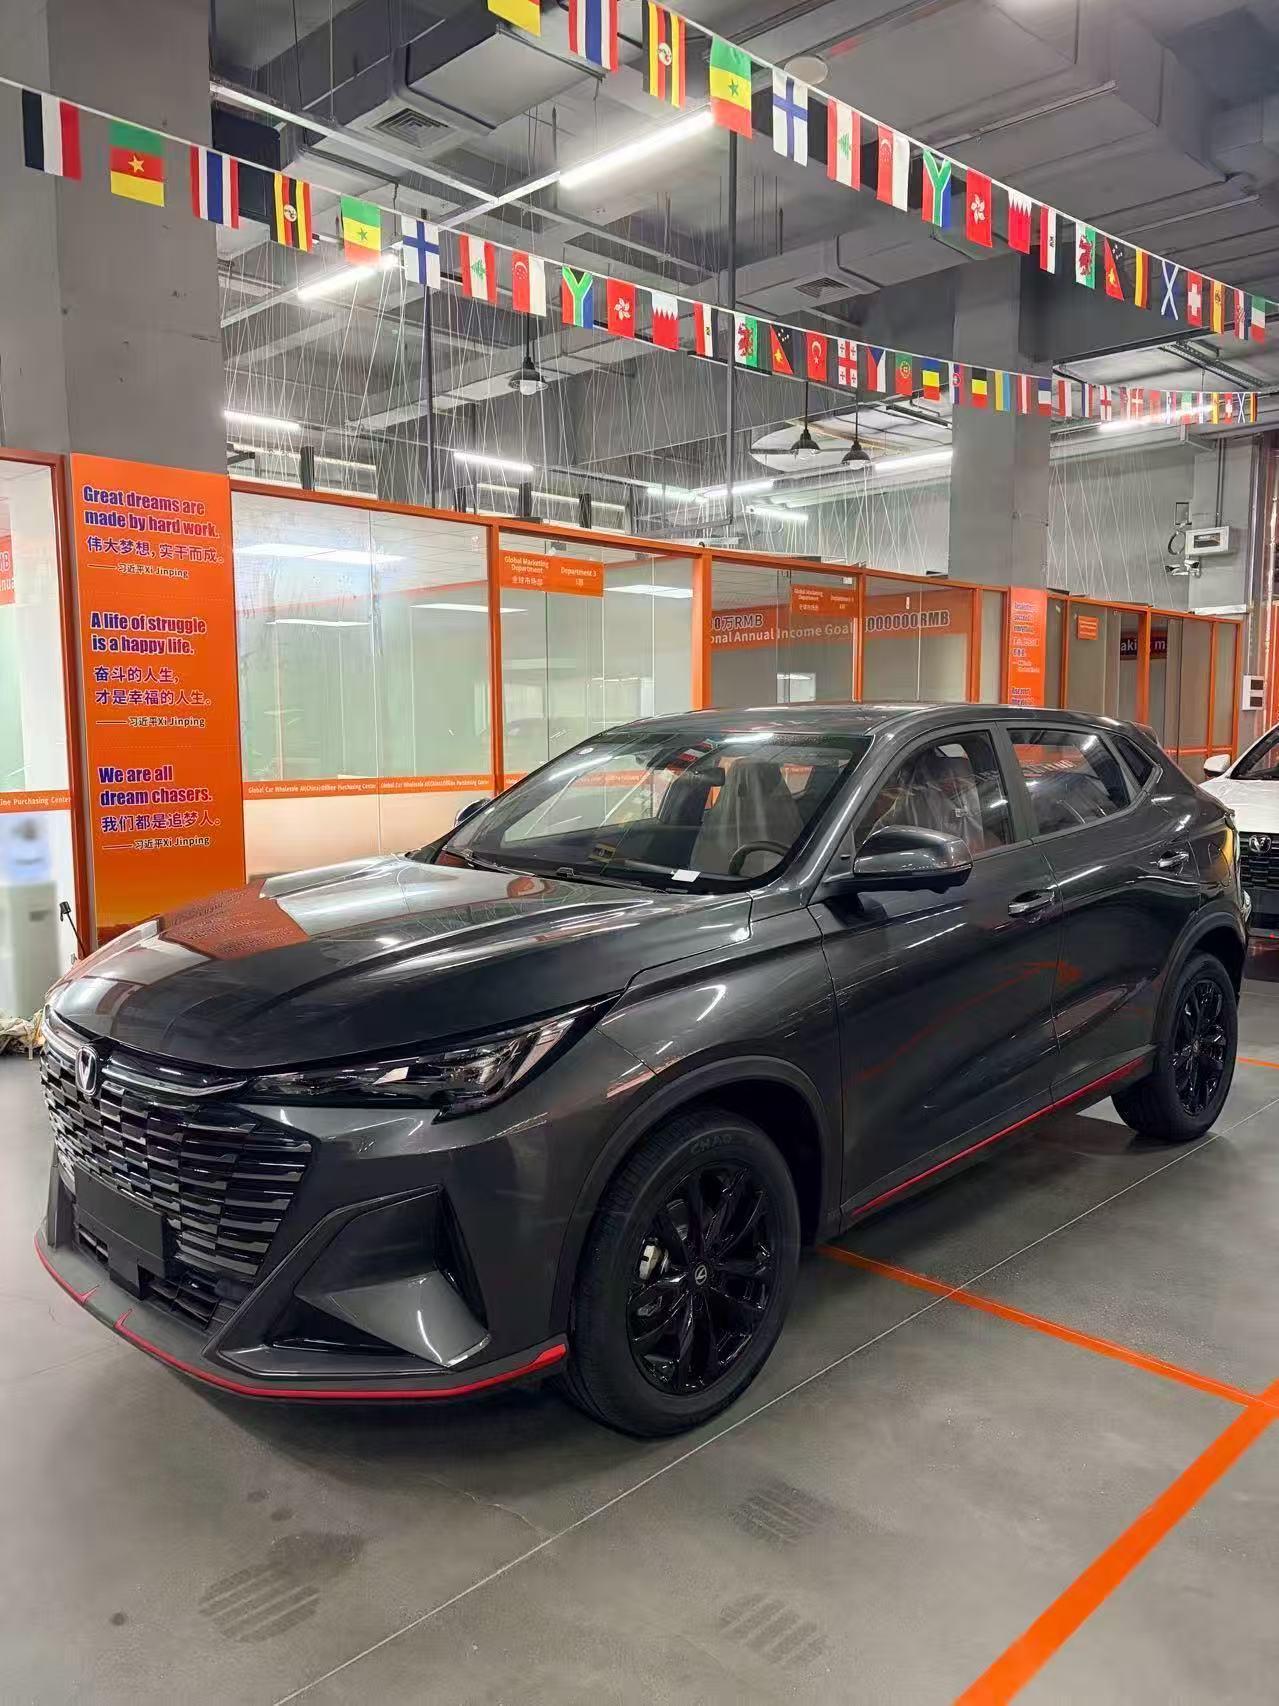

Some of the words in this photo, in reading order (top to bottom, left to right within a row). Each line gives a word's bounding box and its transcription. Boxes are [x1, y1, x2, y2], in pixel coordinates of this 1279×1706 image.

[83, 485, 125, 506] Great
[126, 492, 181, 513] dreams
[182, 501, 206, 516] are
[85, 510, 126, 528] made
[128, 514, 147, 531] by
[149, 516, 181, 534] hard
[182, 520, 220, 539] work.
[504, 556, 521, 564] Global
[155, 565, 188, 578] Jinping
[91, 612, 101, 629] A
[103, 612, 128, 630] life
[131, 614, 146, 631] of
[147, 615, 206, 635] struggle
[733, 628, 775, 642] Annual
[776, 627, 822, 639] Income
[92, 635, 106, 651] is
[109, 637, 118, 652] a
[121, 635, 166, 655] happy
[167, 637, 194, 655] life.
[94, 666, 180, 684] 奋斗的人生，
[95, 689, 212, 706] 才是幸福的人生。
[169, 717, 205, 729] Jinping
[98, 767, 124, 784] We
[126, 767, 152, 782] are
[154, 765, 174, 781] all
[13, 797, 49, 806] Purchasing
[100, 790, 149, 807] dream
[151, 787, 213, 804] chasers.
[101, 810, 221, 833] 我们都是追梦人。
[175, 836, 210, 848] Jinping
